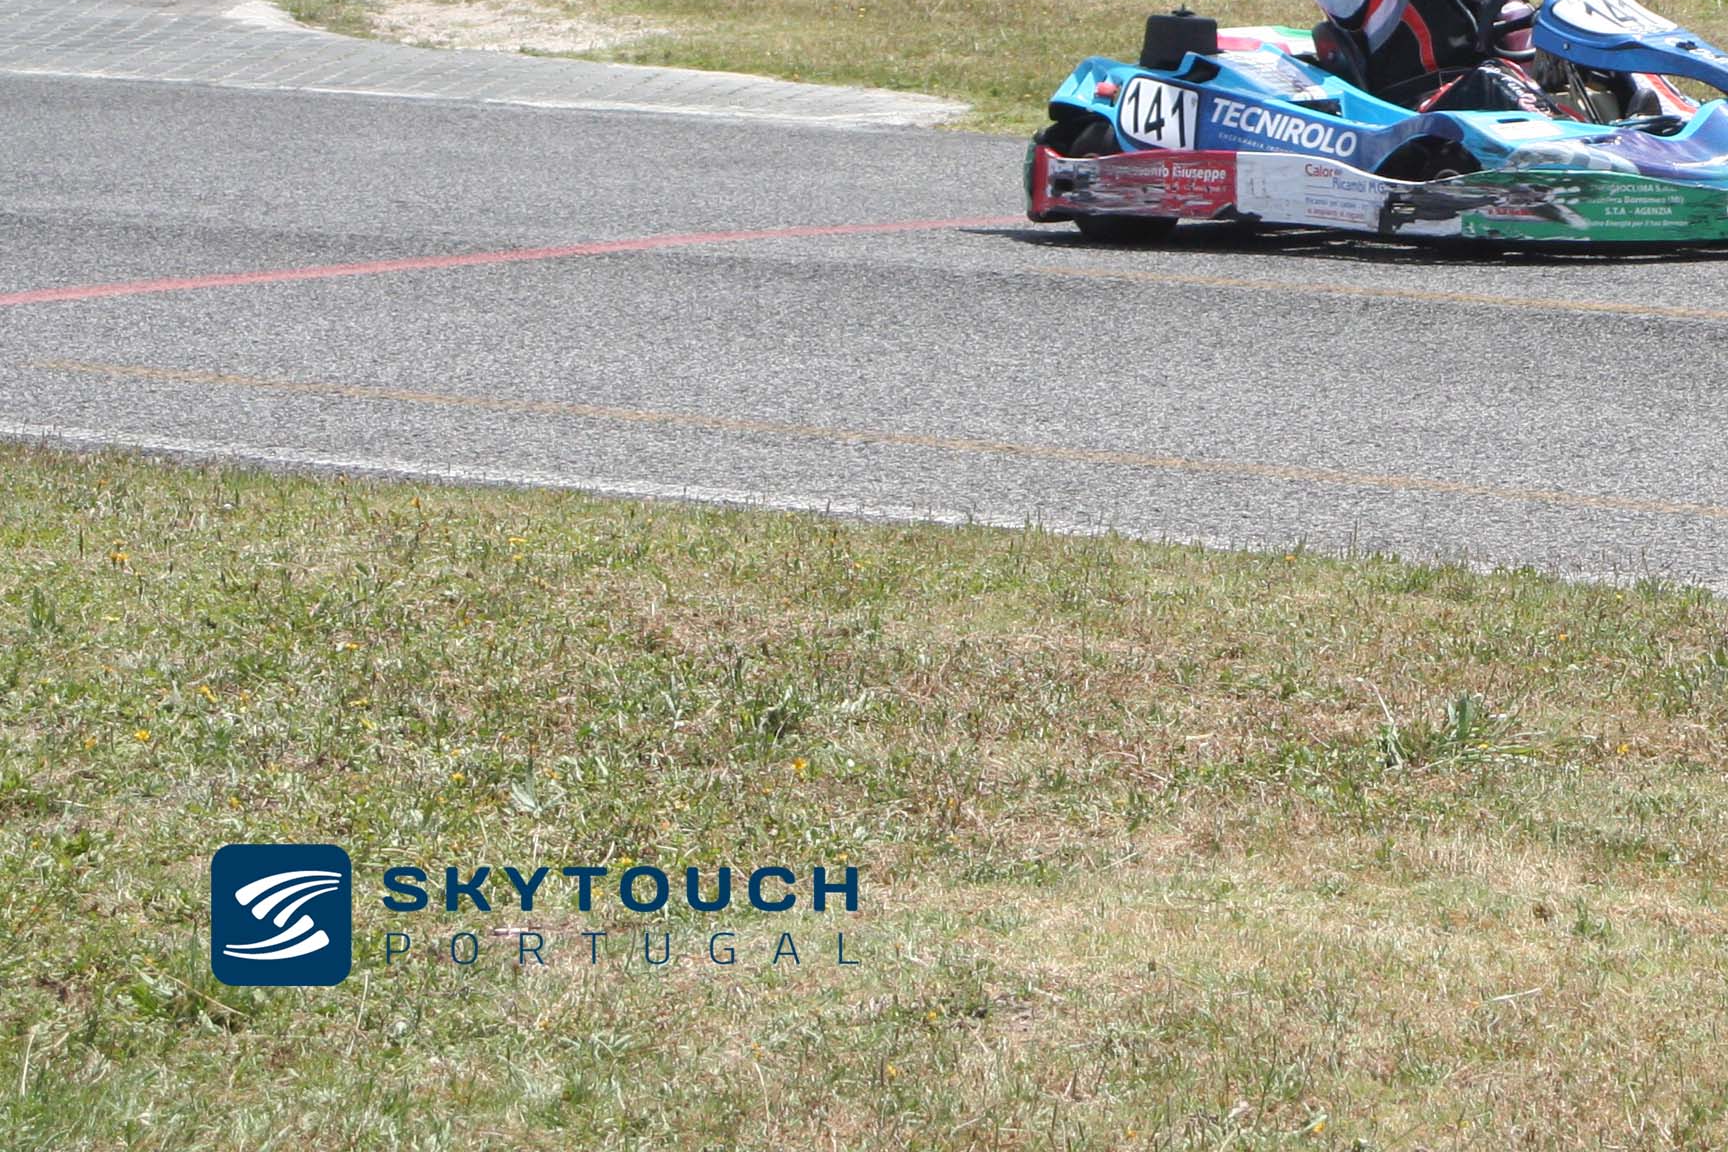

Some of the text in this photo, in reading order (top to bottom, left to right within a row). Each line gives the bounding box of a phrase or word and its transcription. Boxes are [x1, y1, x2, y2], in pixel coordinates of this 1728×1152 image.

[1126, 81, 1187, 148] 141
[1210, 97, 1357, 159] TECNIROLO
[1633, 207, 1673, 216] AGENZIA
